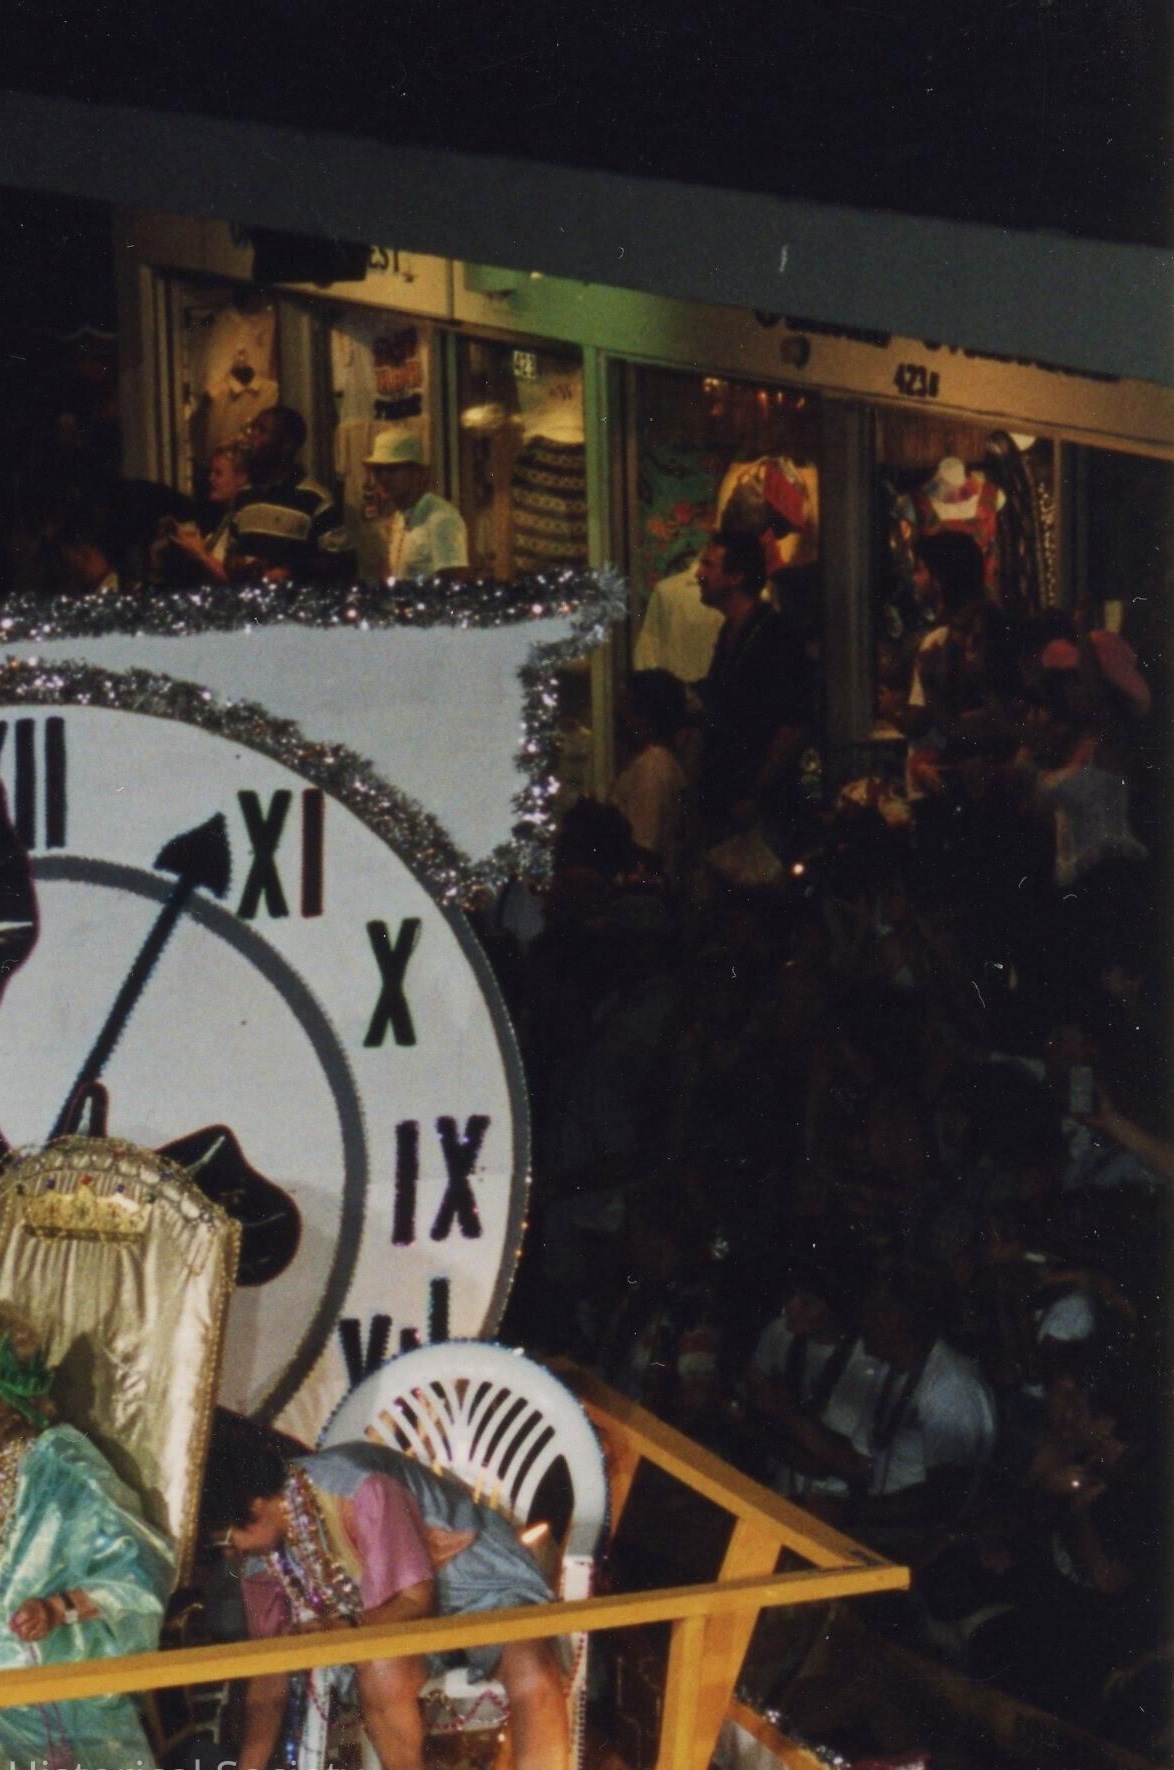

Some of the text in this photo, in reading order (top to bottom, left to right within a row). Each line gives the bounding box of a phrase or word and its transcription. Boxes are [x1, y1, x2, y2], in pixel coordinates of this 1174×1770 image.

[237, 787, 326, 918] XI
[363, 918, 421, 1048] X
[392, 1115, 490, 1245] IX
